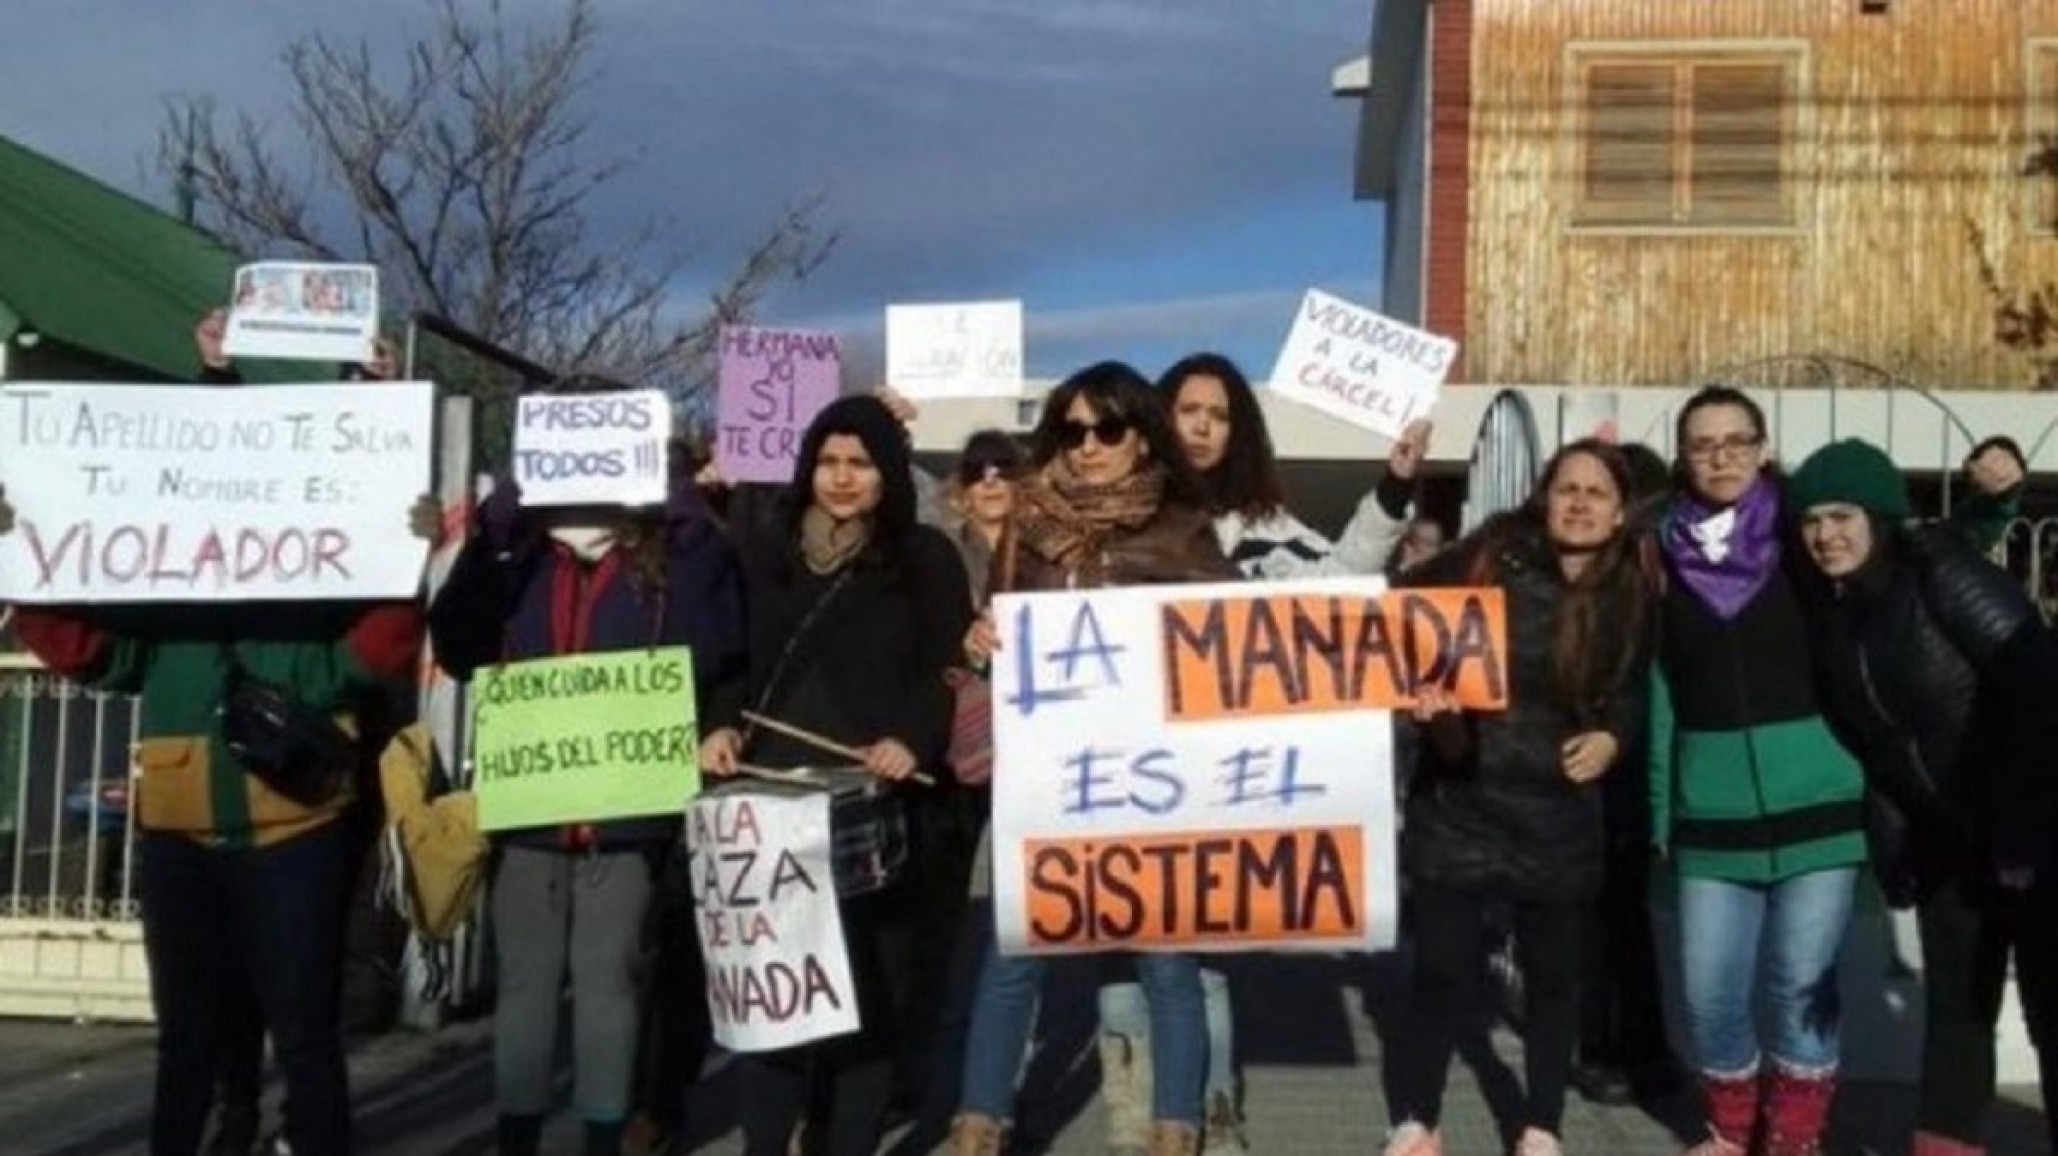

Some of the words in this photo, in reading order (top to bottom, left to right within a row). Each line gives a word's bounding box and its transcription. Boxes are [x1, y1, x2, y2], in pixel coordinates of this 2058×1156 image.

[724, 330, 839, 361] HERMANA
[5, 390, 60, 446] TU
[68, 401, 220, 451] APELLIDO
[230, 419, 275, 450] NO
[283, 412, 315, 451] TE
[331, 411, 413, 453] SALVA
[521, 399, 652, 431] PRESOS
[721, 425, 752, 456] TE
[759, 426, 800, 460] CR
[79, 464, 126, 495] TU
[157, 467, 281, 502] NOMBRE
[518, 449, 625, 481] TODOS
[20, 519, 352, 590] VIOLADOR
[1005, 600, 1125, 715] LA
[1162, 593, 1503, 714] MANADA
[634, 660, 683, 695] LOS
[480, 740, 553, 782] HIJOS
[556, 734, 602, 770] DEL
[1062, 749, 1186, 815] ES
[1216, 745, 1326, 806] EL
[736, 911, 778, 945] LA
